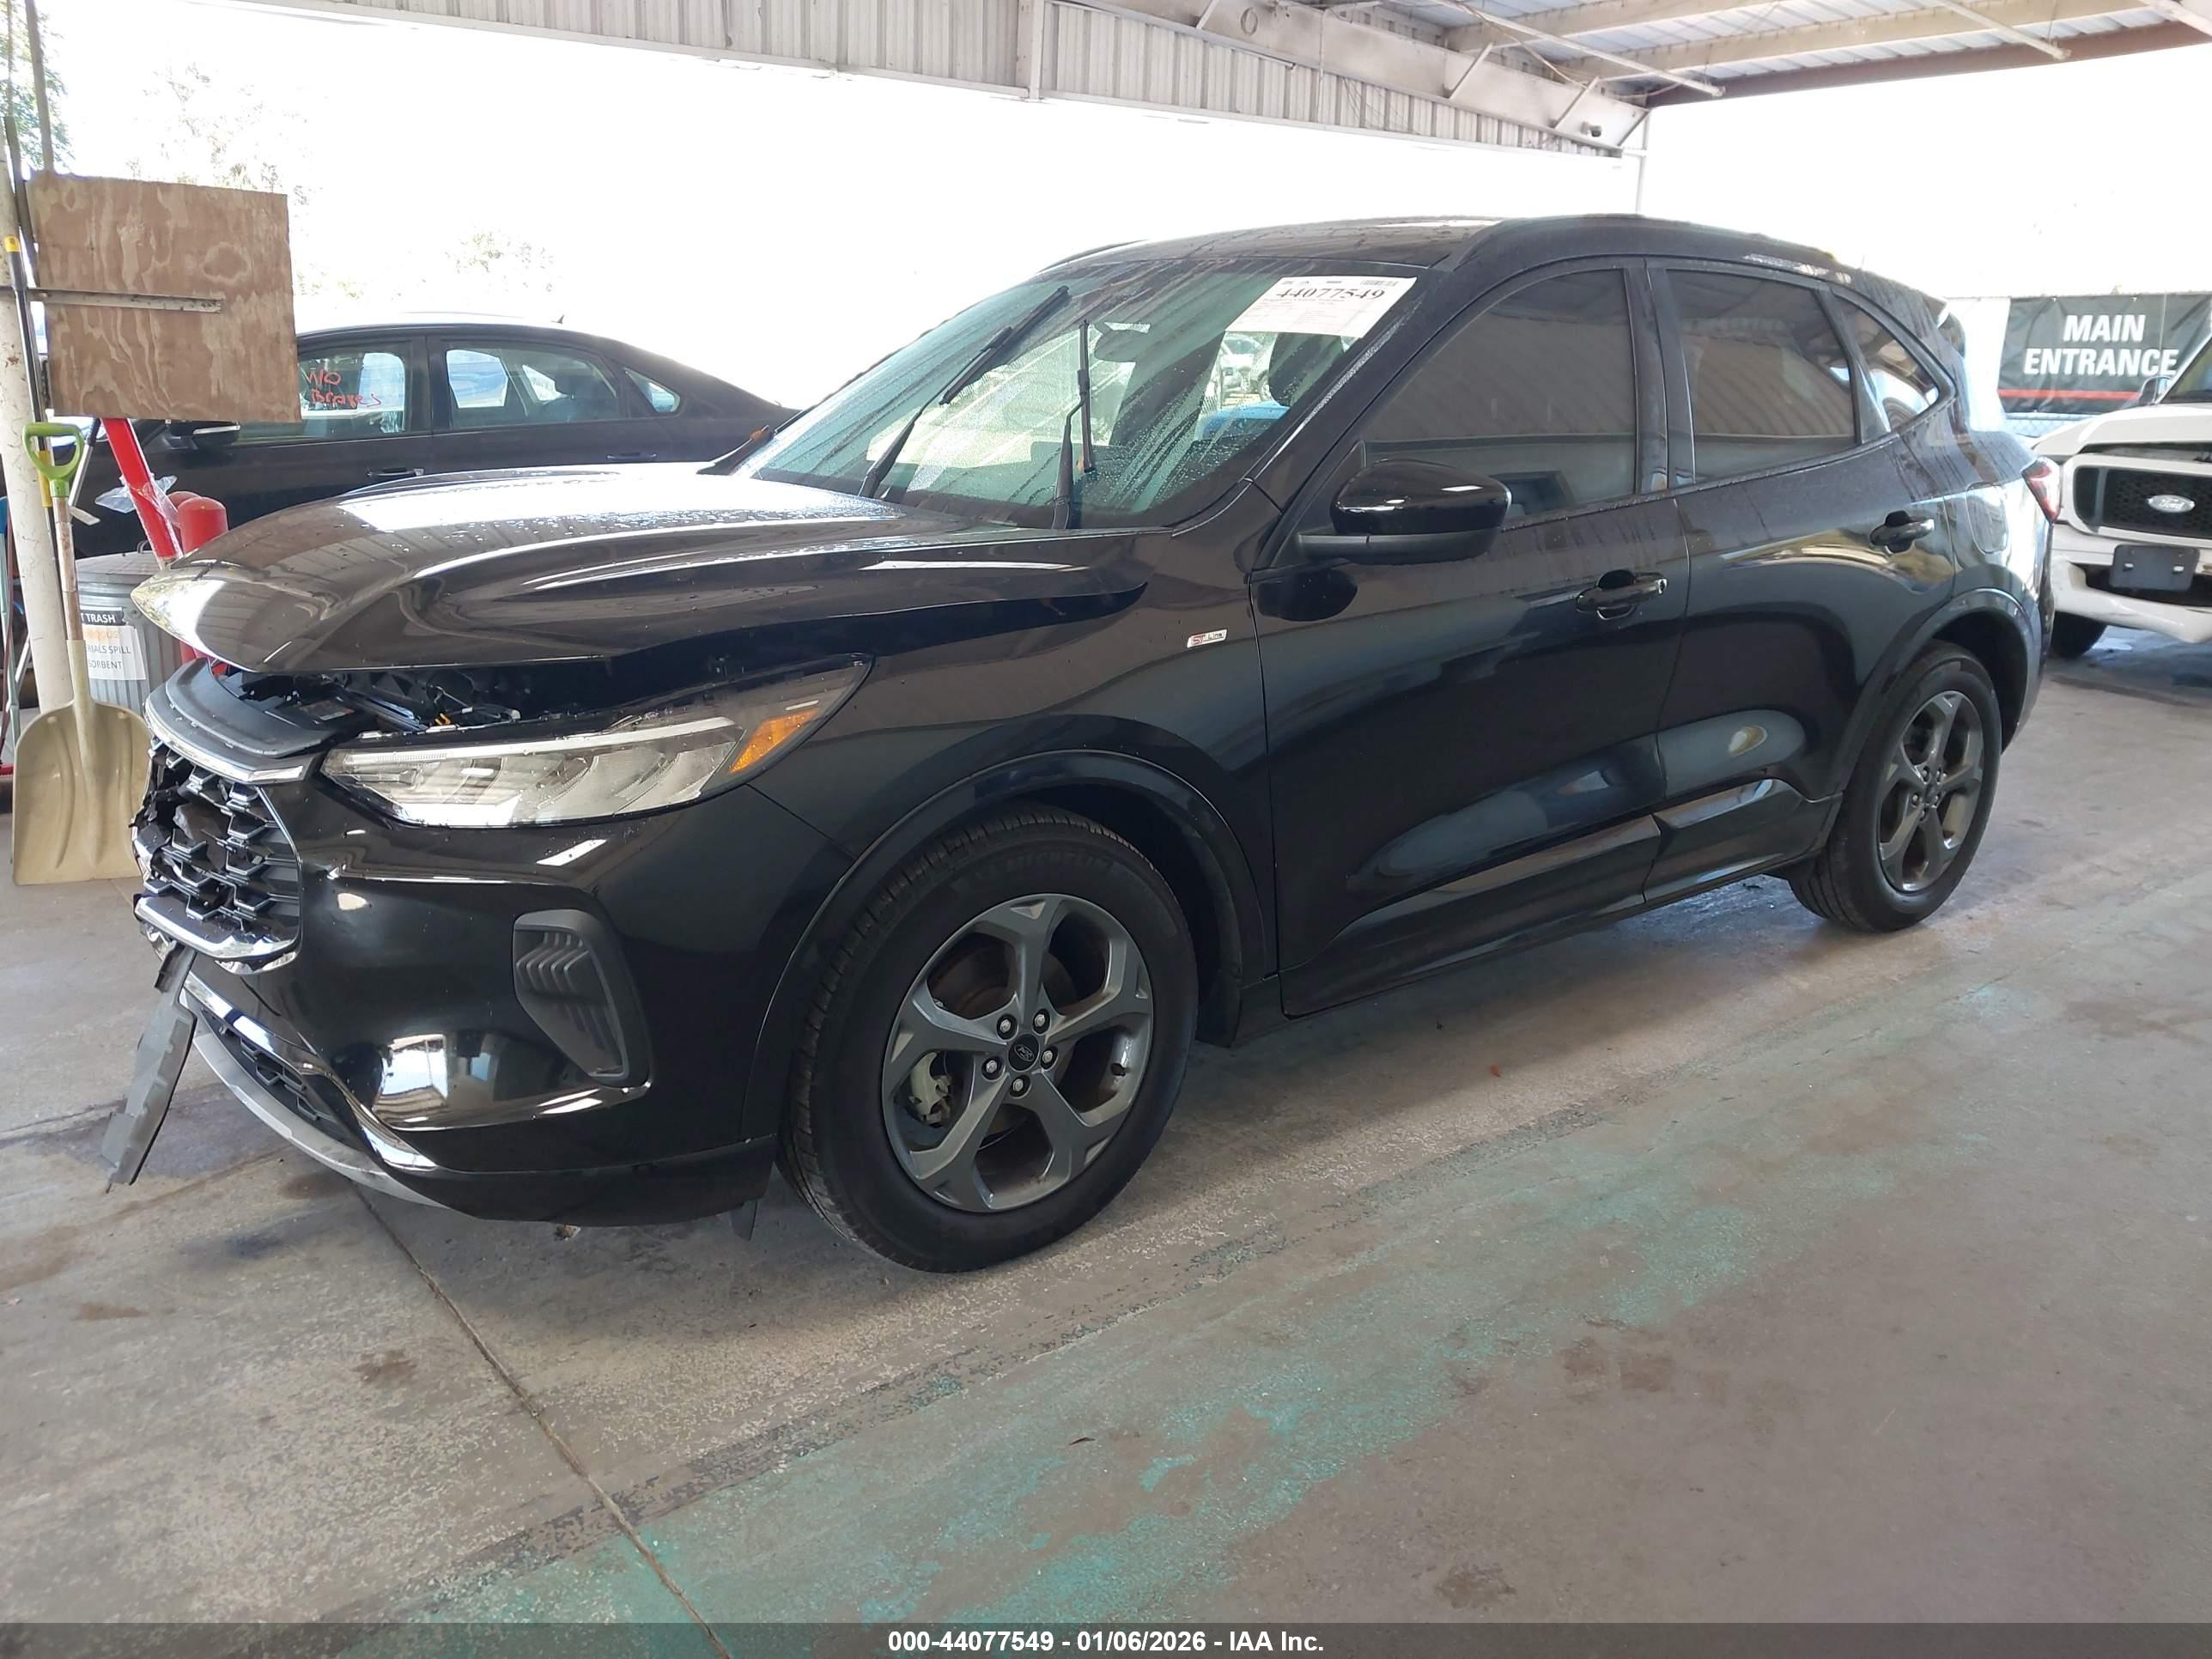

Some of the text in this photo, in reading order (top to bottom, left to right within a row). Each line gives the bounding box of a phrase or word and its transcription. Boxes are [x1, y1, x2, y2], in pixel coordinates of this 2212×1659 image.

[1276, 288, 1386, 300] 44077549
[2063, 314, 2147, 342] MAIN
[2023, 348, 2179, 376] ENTRANCE
[86, 612, 116, 623] TRASH
[87, 644, 131, 654] RIALS SPILL
[88, 660, 123, 670] SORBENT
